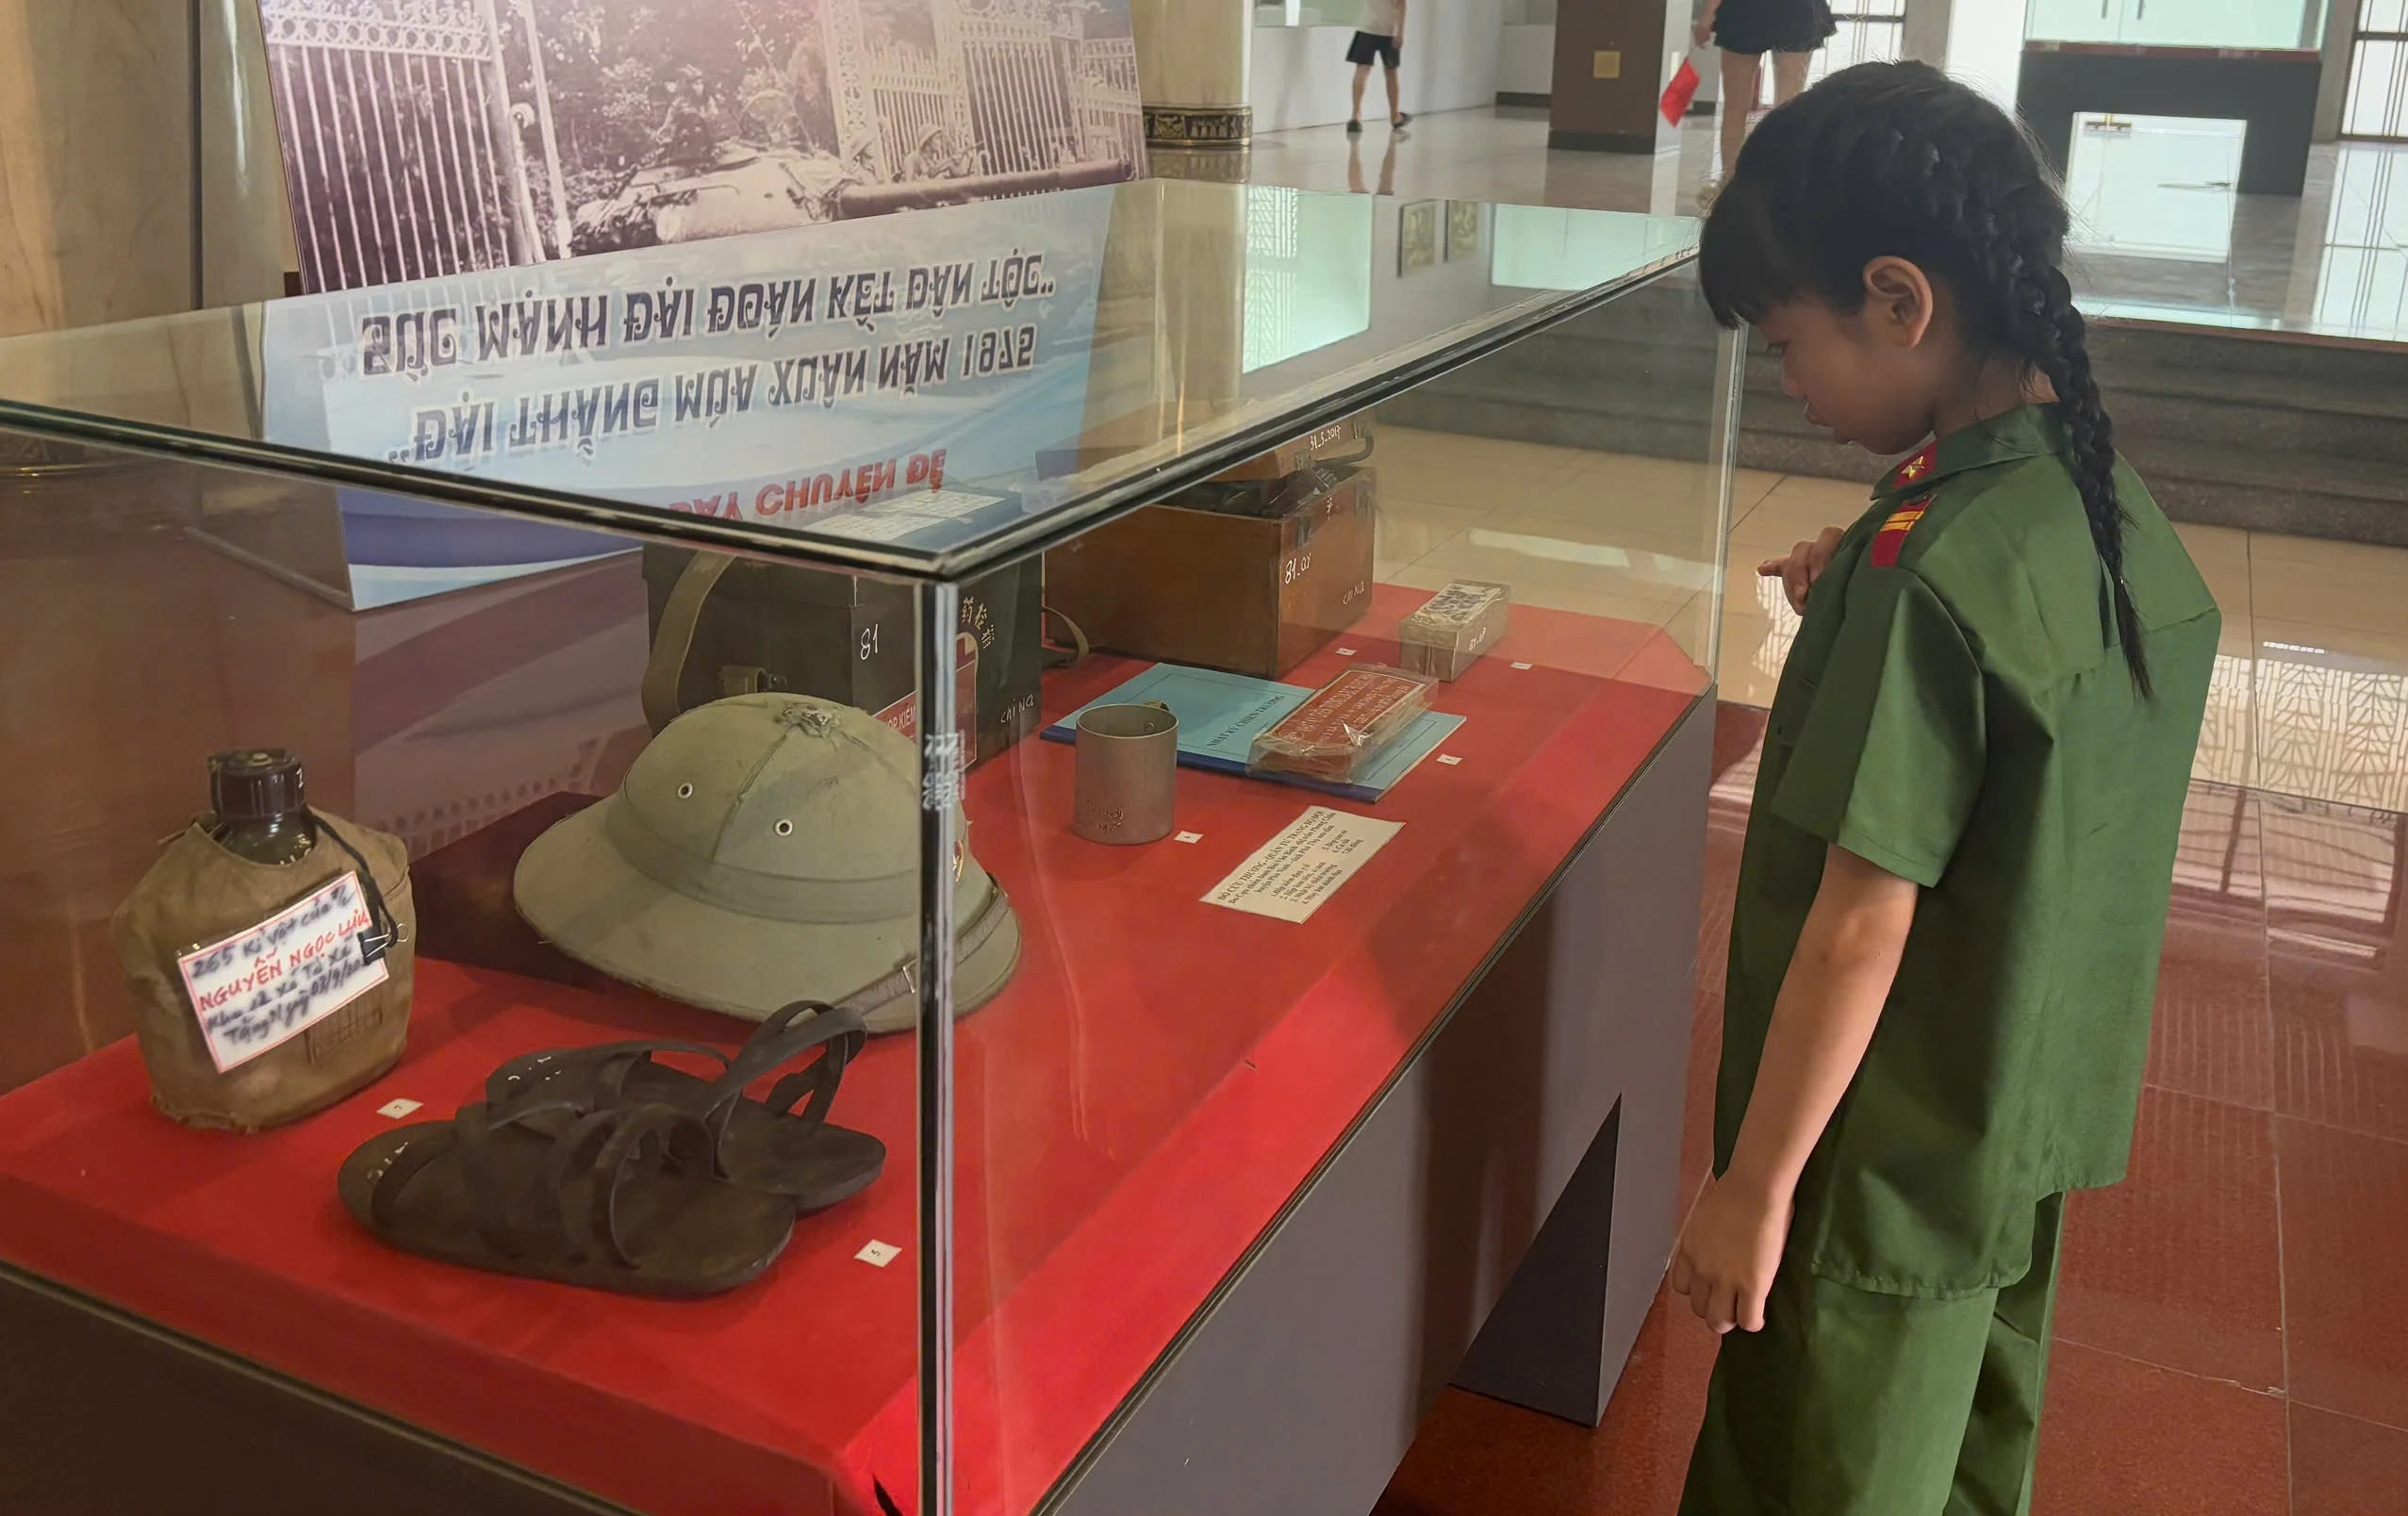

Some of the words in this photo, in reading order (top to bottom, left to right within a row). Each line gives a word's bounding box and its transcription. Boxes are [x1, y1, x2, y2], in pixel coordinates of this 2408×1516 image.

[860, 623, 879, 661] 81
[199, 947, 283, 1012] NGUYỄN
[289, 931, 336, 967] NGỌC
